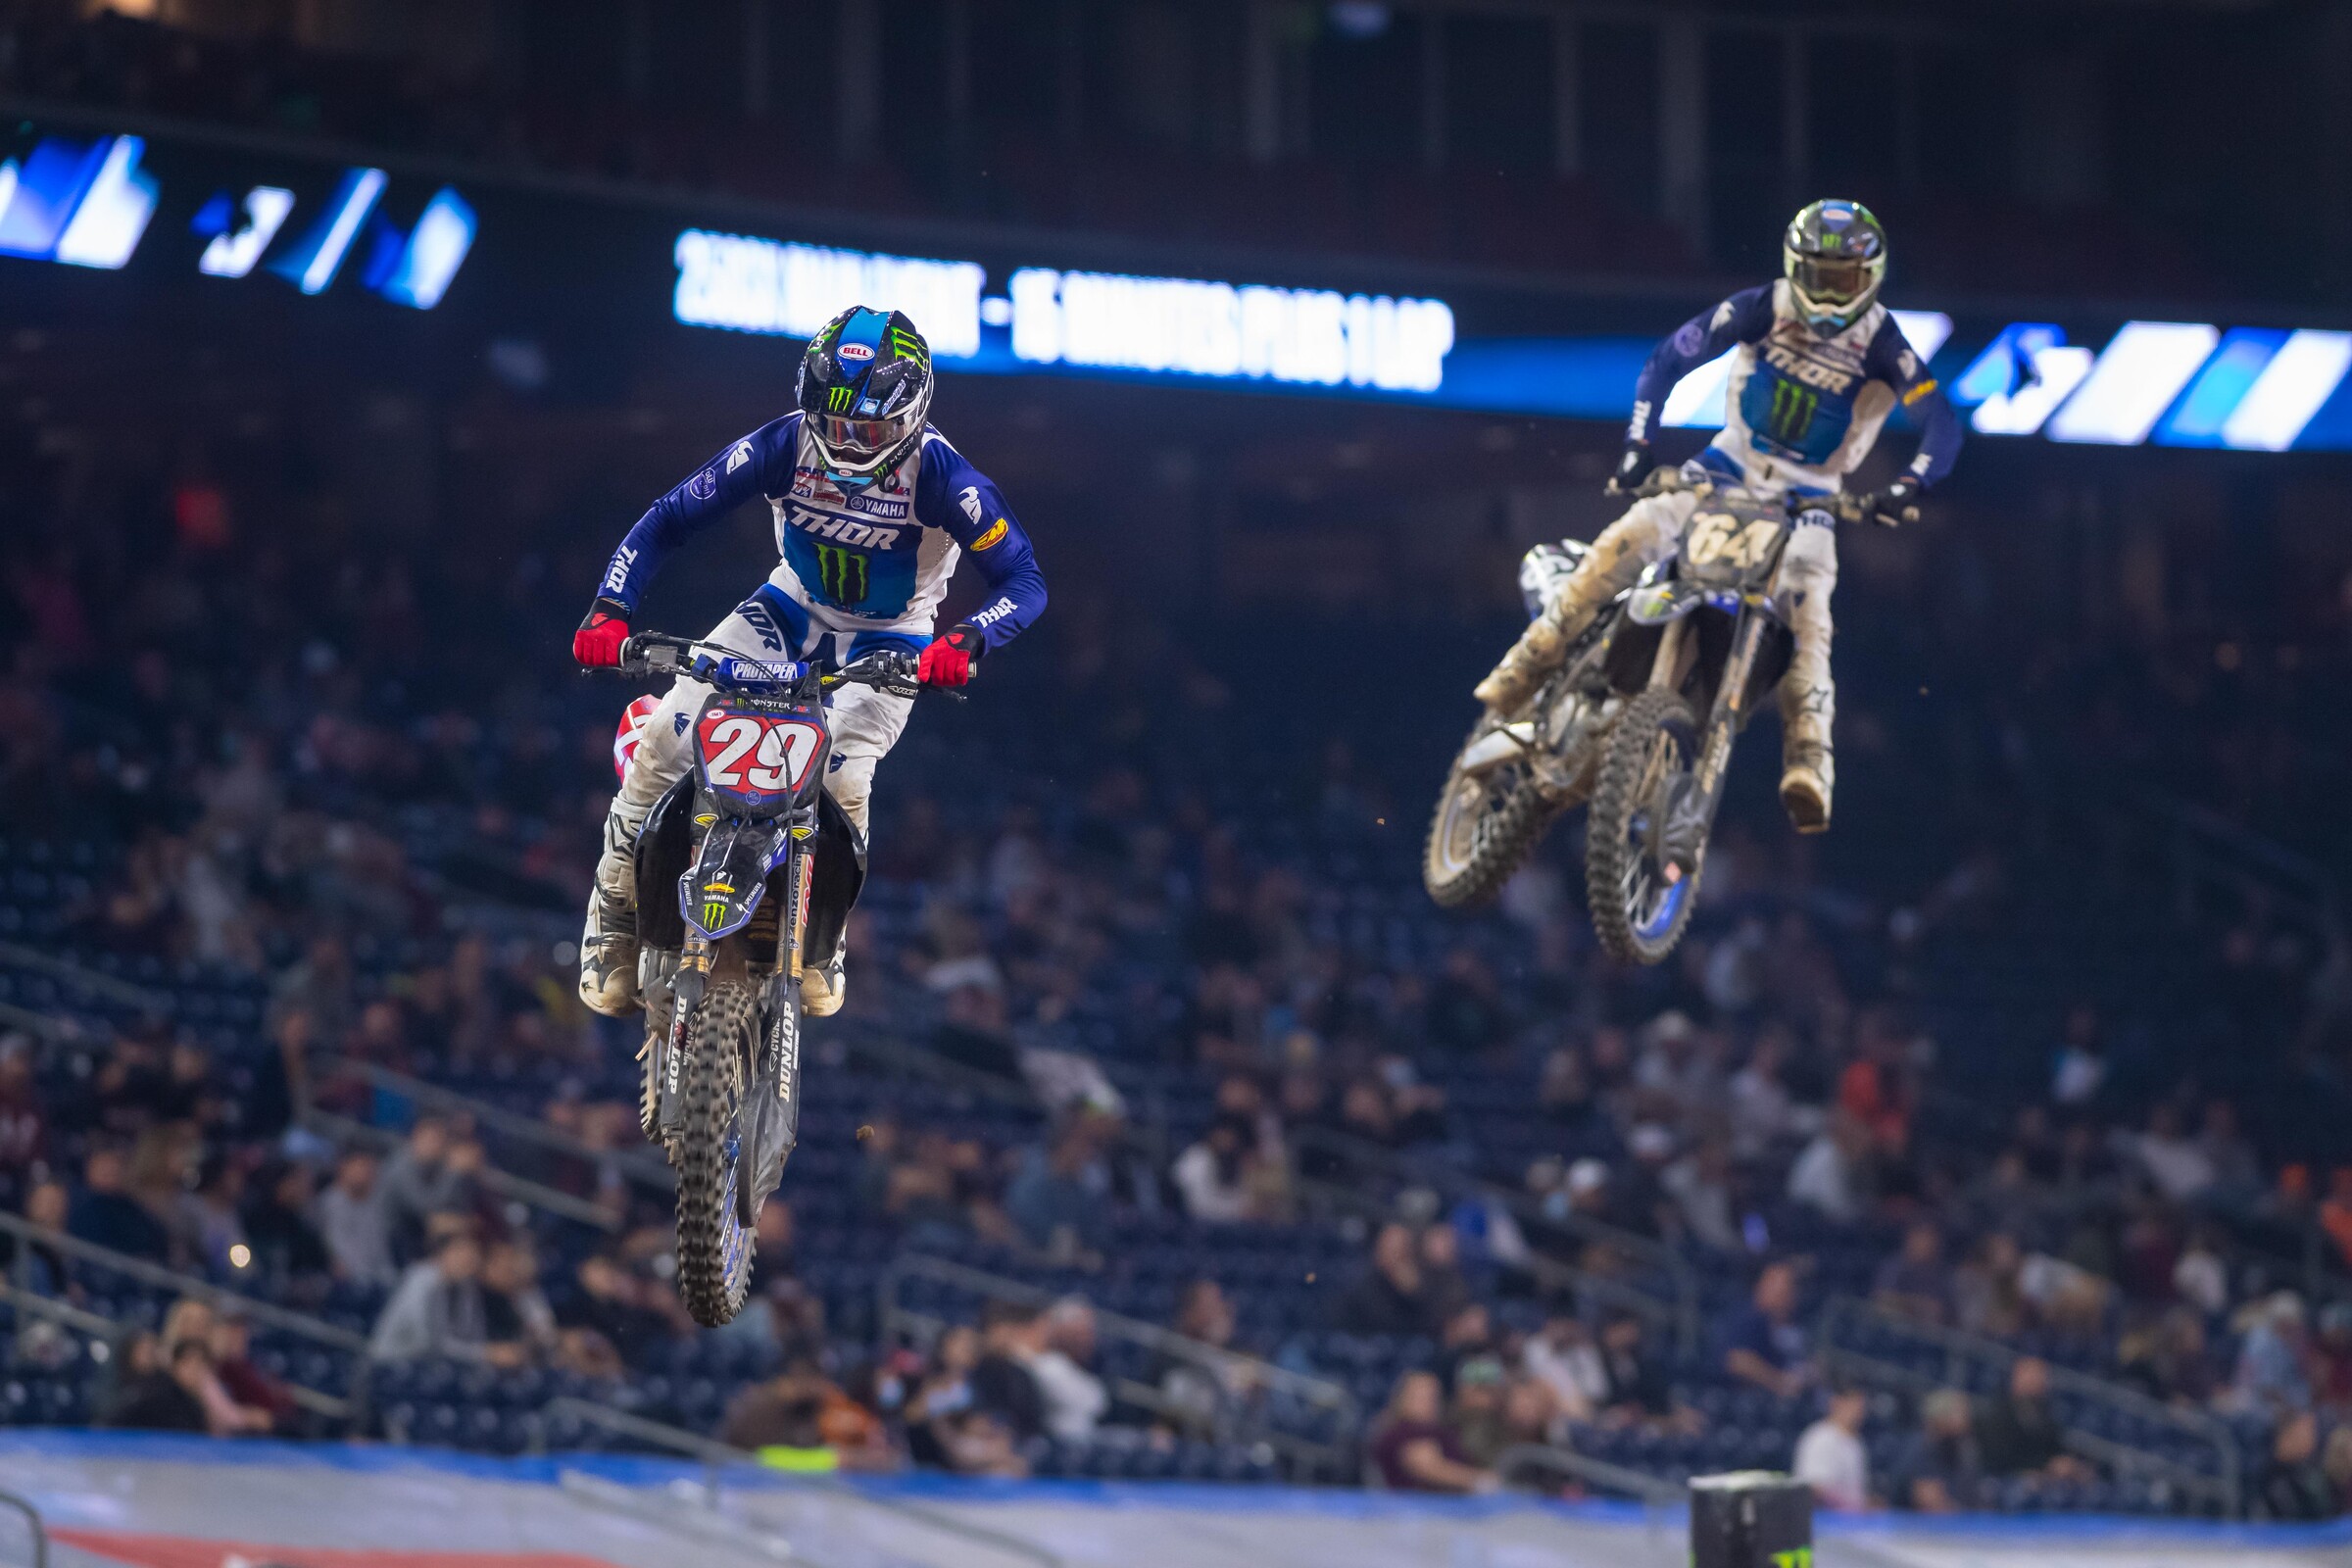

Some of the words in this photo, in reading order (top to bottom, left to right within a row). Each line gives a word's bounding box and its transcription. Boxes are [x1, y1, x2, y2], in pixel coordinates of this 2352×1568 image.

[843, 347, 868, 357] BELL
[1766, 347, 1853, 396] THOR
[790, 506, 900, 550] THOR
[865, 501, 906, 517] YAMAHA
[1688, 514, 1781, 568] 64
[606, 545, 638, 594] THOR
[971, 596, 1018, 628] THOR
[747, 698, 790, 710] ONSTER
[888, 686, 916, 696] ARC
[708, 718, 817, 790] 29
[704, 894, 729, 903] YAMAHA
[668, 995, 687, 1094] DULOP
[779, 1001, 795, 1102] DUNLOP
